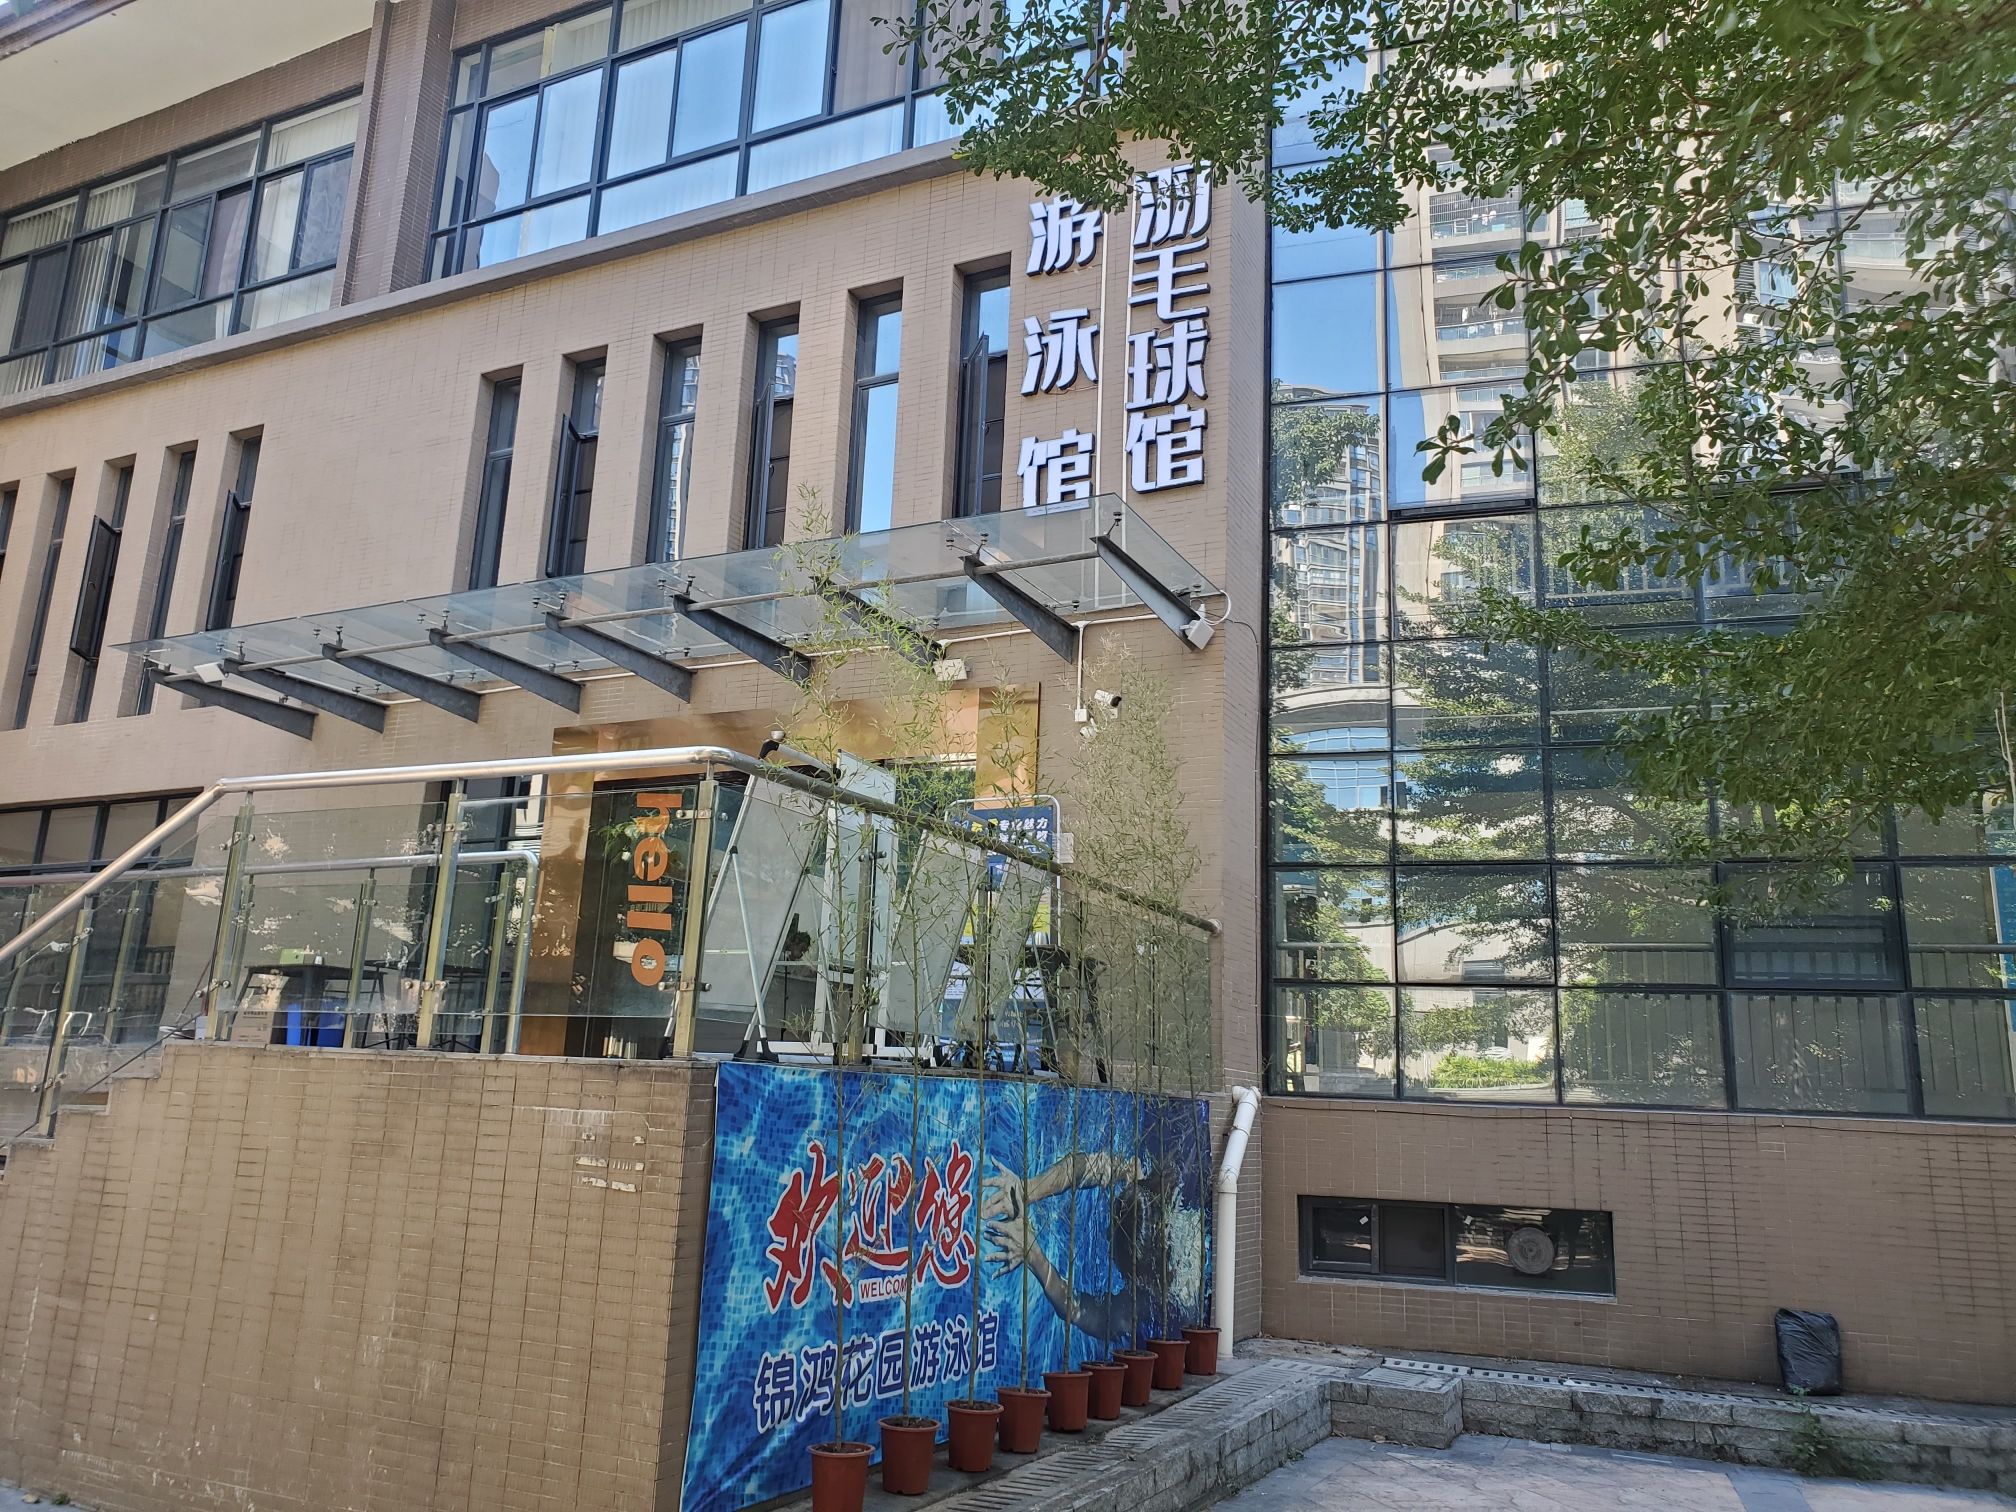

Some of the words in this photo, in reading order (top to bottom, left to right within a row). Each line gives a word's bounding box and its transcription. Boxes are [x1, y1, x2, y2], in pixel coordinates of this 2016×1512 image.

[1016, 192, 1103, 516] 游泳馆
[1125, 160, 1212, 493] 羽毛球馆
[626, 793, 682, 986] hello
[765, 1140, 976, 1311] 欢迎您
[860, 1277, 914, 1299] WELCOM
[755, 1311, 998, 1430] 锦鸿花园游泳馆
